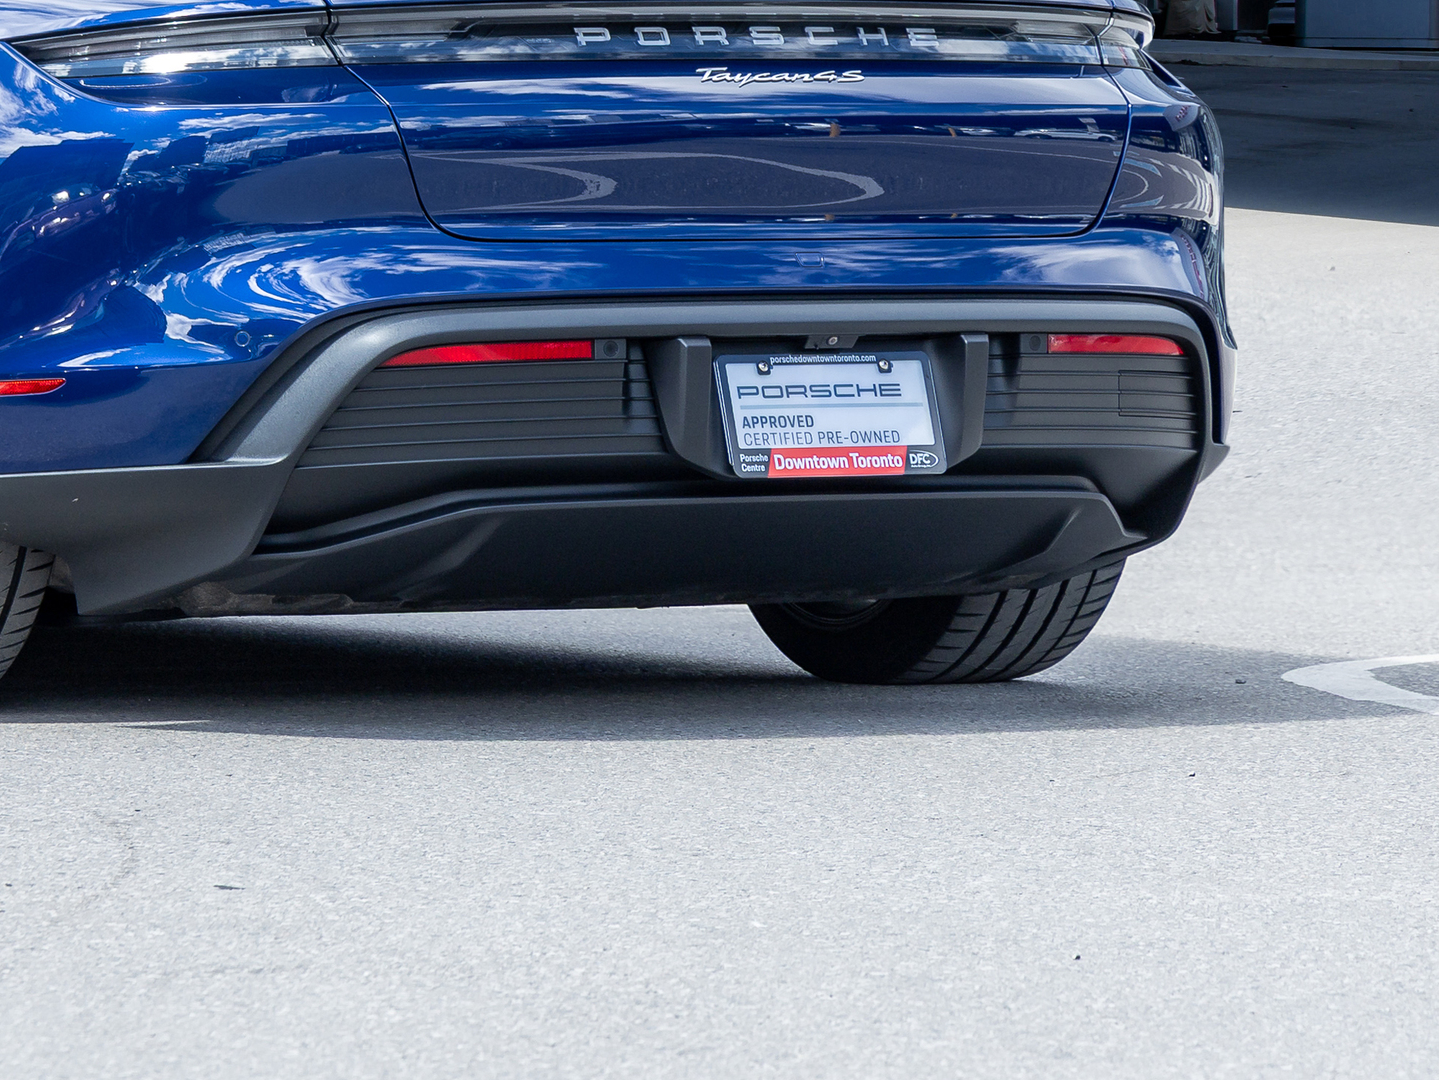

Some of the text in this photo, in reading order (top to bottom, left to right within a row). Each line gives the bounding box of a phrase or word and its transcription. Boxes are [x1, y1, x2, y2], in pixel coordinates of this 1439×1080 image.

[573, 25, 941, 47] PORSCHE
[769, 353, 877, 366] porschedowntowntoronto.com
[736, 383, 903, 399] PORSCHE
[742, 414, 815, 429] APPROVED
[743, 429, 901, 447] CERTIFIED PRE-OWNED
[739, 453, 770, 464] Porsche
[773, 452, 904, 471] Downtown Toronto
[909, 453, 931, 465] DFC
[741, 463, 766, 472] Centre
